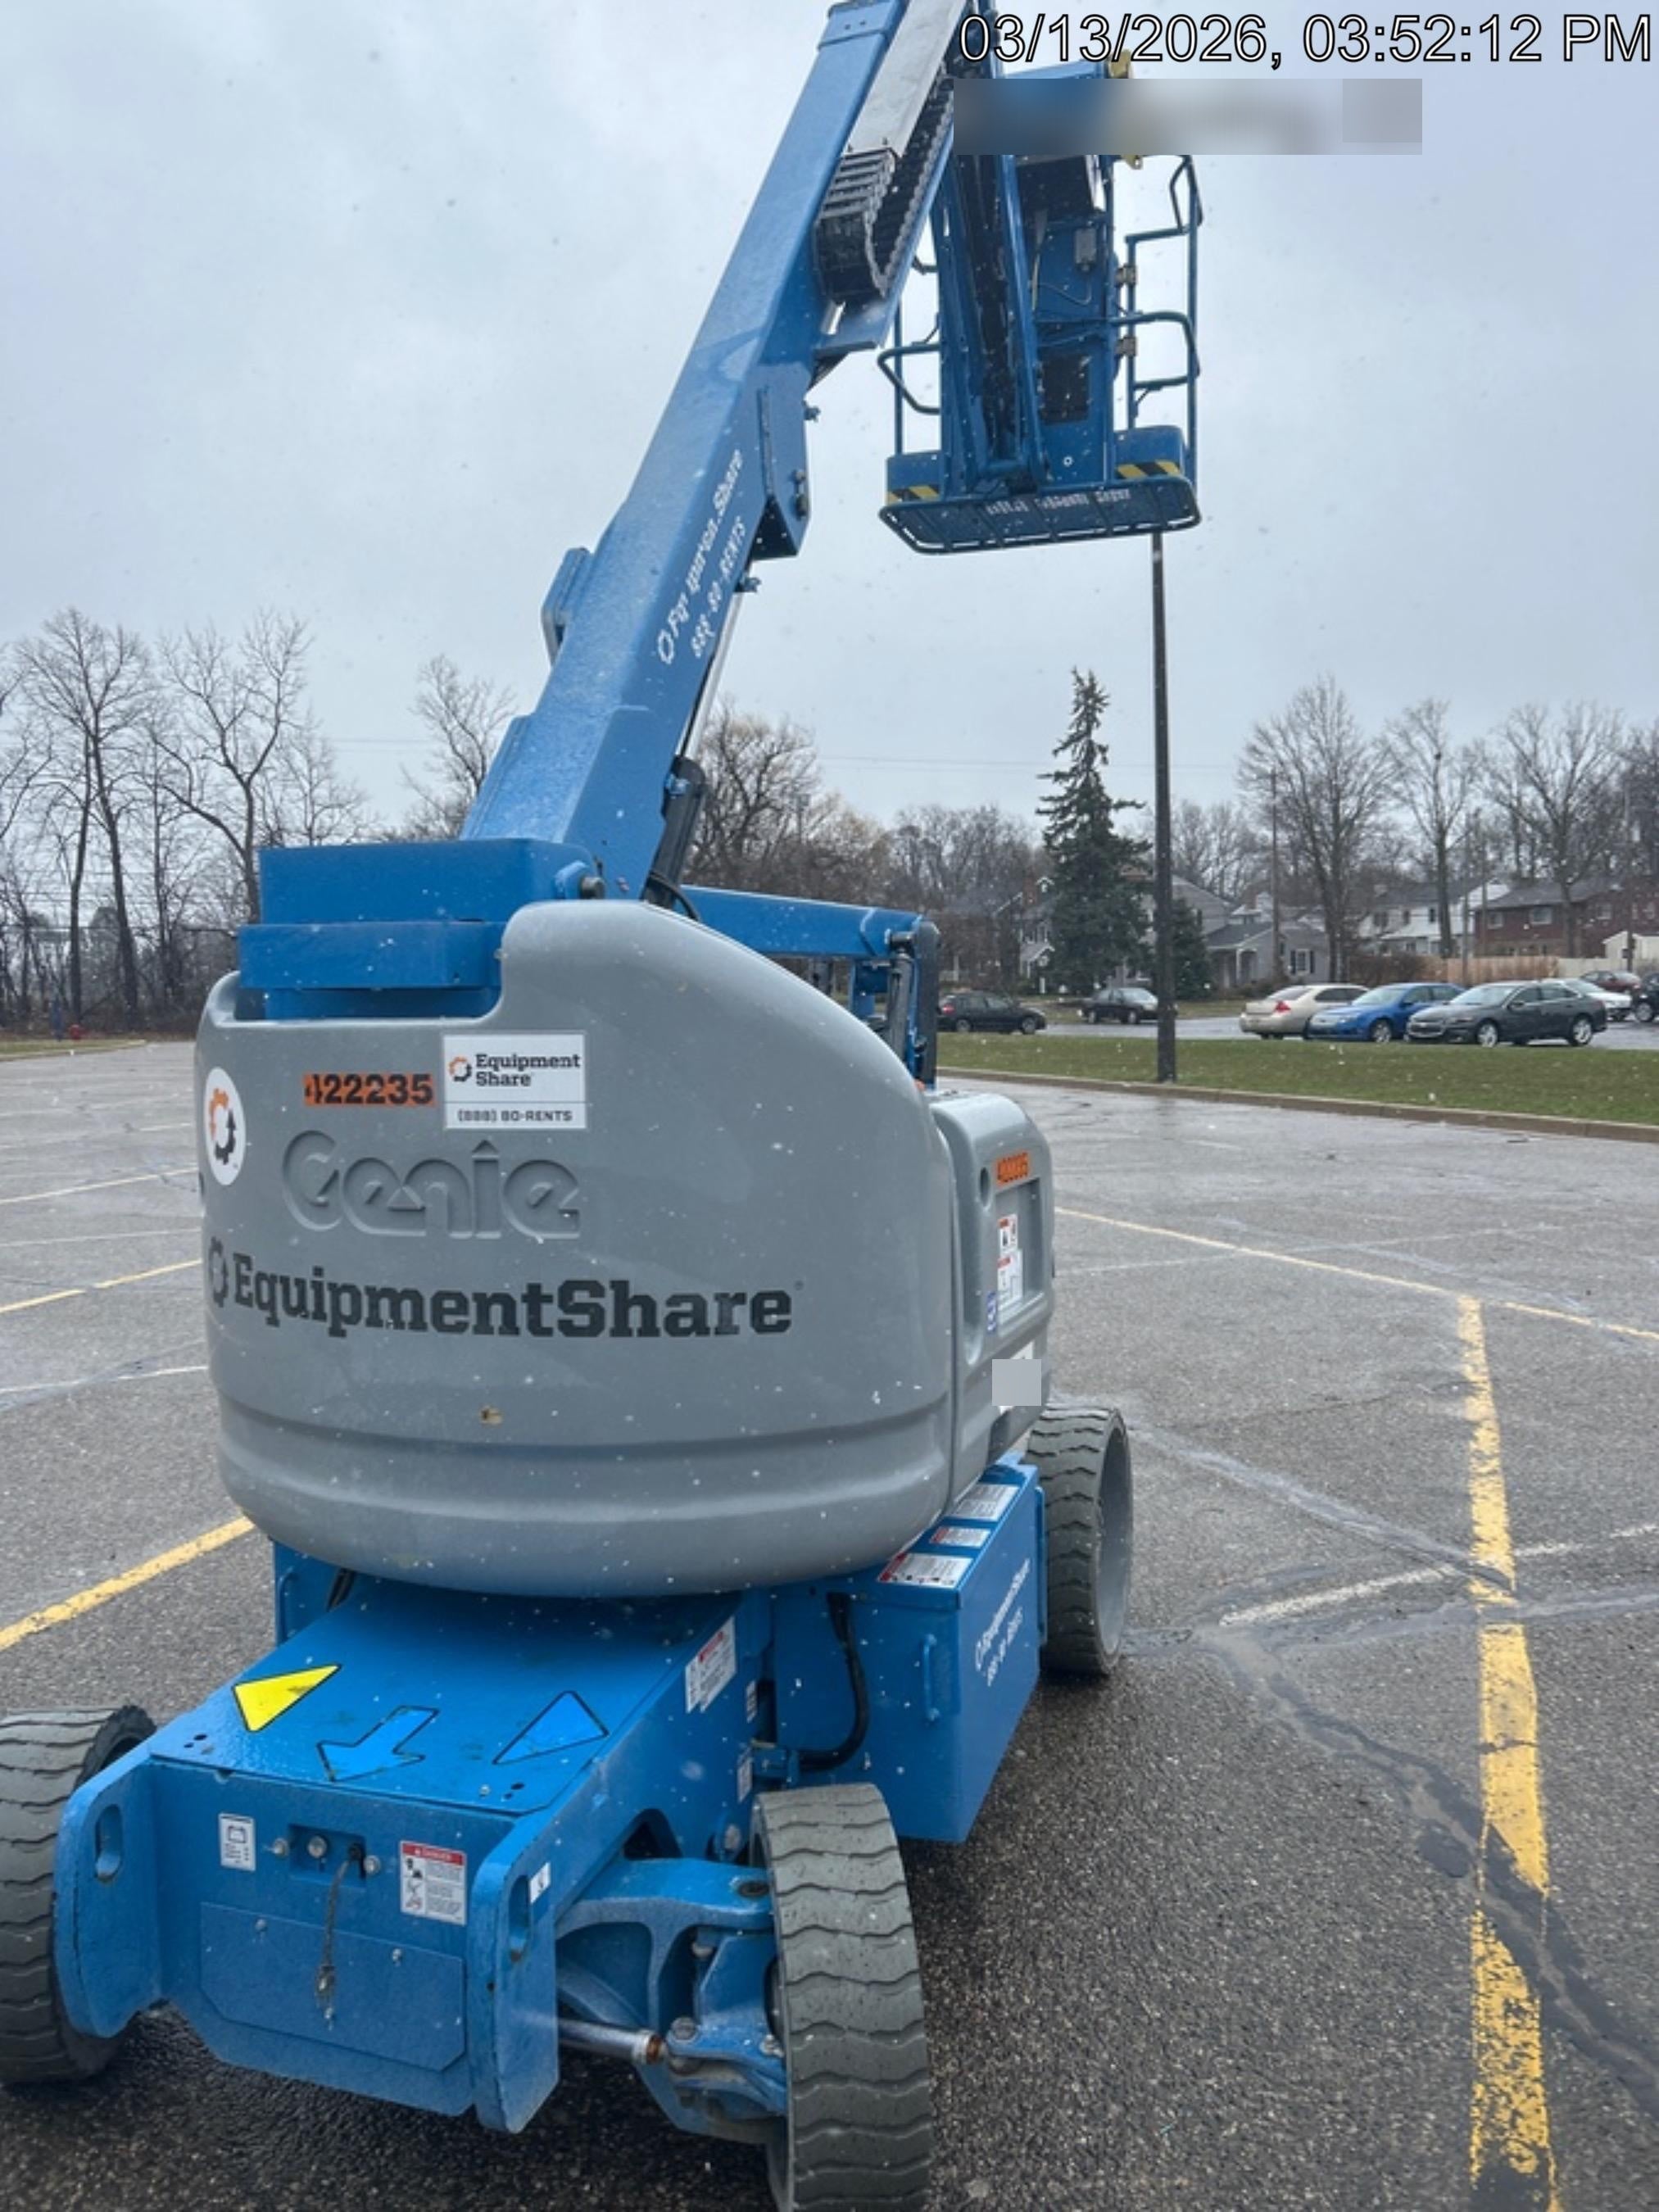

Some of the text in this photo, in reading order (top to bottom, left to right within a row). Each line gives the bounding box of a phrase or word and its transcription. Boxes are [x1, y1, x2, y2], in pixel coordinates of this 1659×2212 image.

[475, 1053, 581, 1072] Equipment
[304, 1073, 433, 1104] 422235
[475, 1071, 532, 1087] Share
[282, 1129, 580, 1240] Genie
[233, 1253, 793, 1339] EquipmentShare
